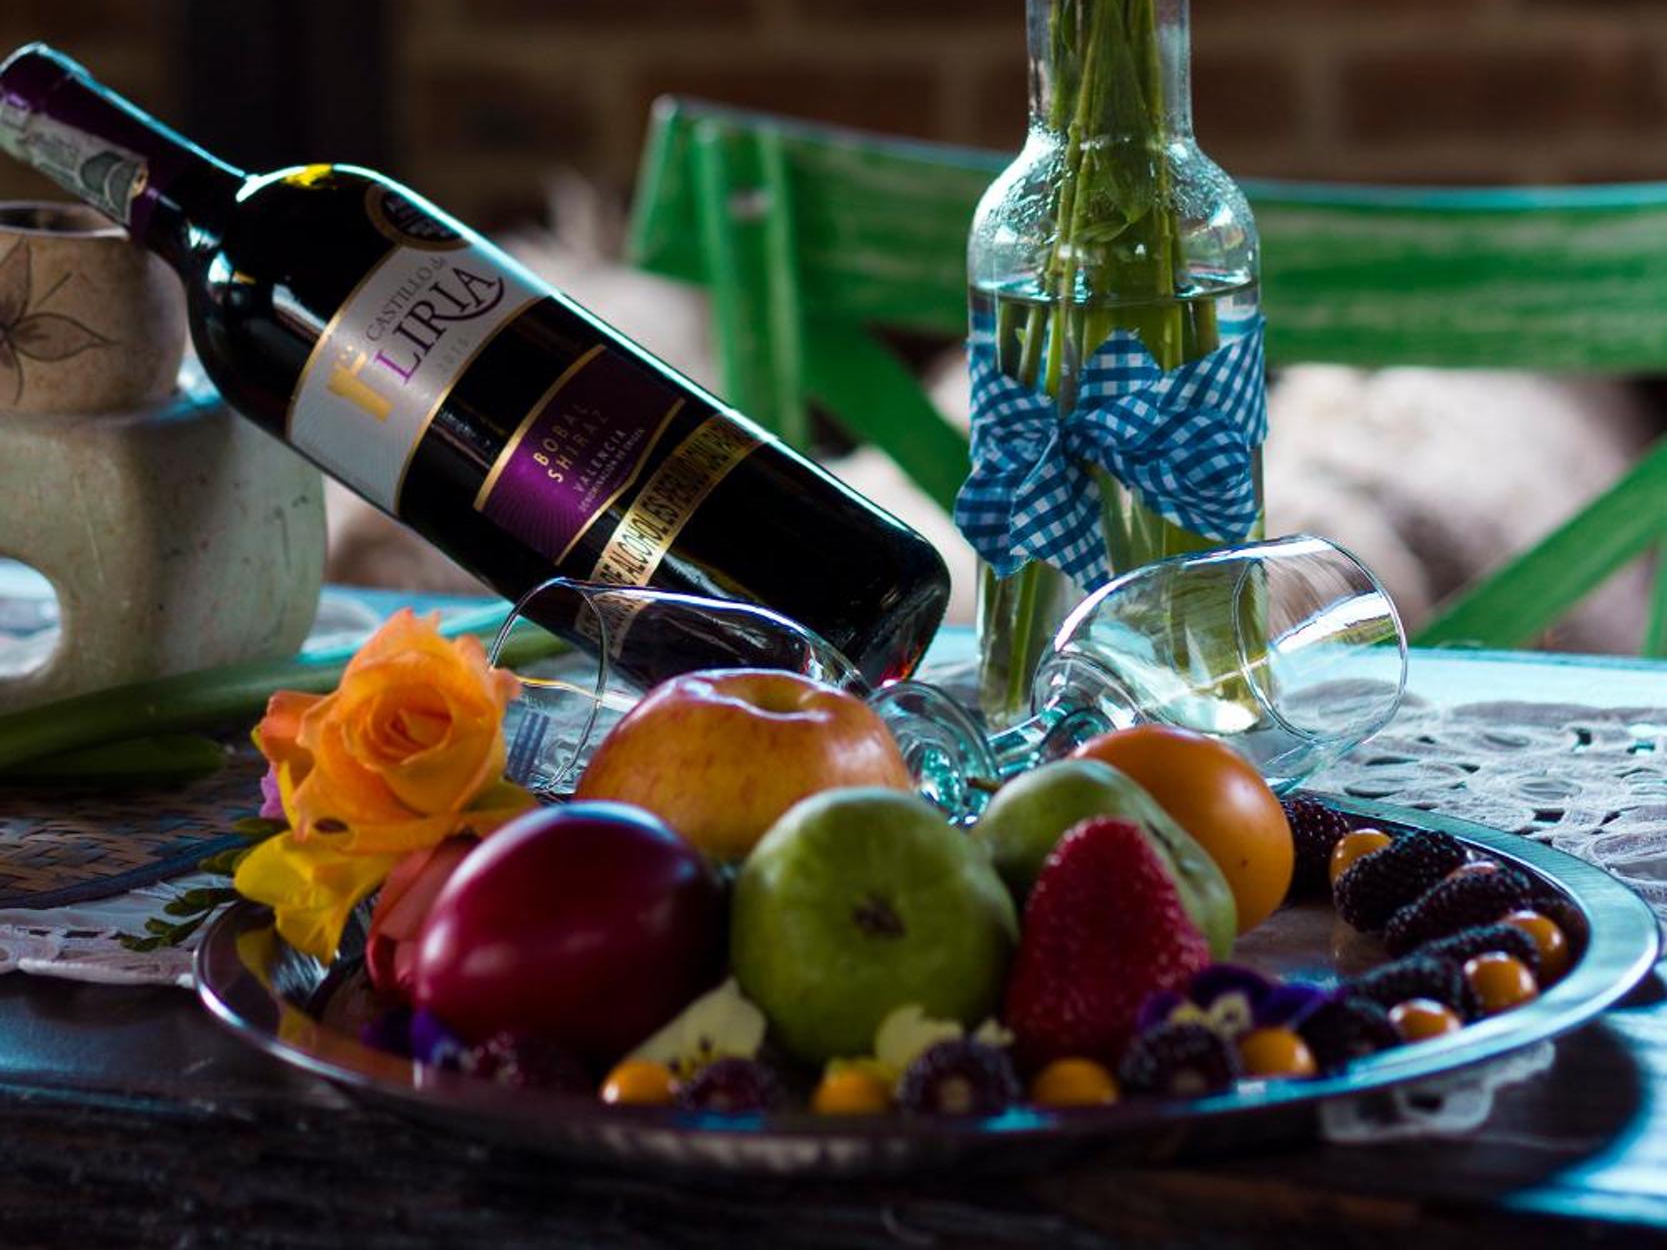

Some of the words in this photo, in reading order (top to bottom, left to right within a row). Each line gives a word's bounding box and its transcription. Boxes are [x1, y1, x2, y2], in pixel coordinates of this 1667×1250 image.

[365, 266, 433, 341] CASTILLO
[374, 267, 504, 385] LIRIA
[532, 404, 588, 466] BOBAL
[547, 410, 608, 483] SHIRAZ
[572, 430, 627, 492] VALENCIA
[608, 512, 669, 580] ALCOHOL
